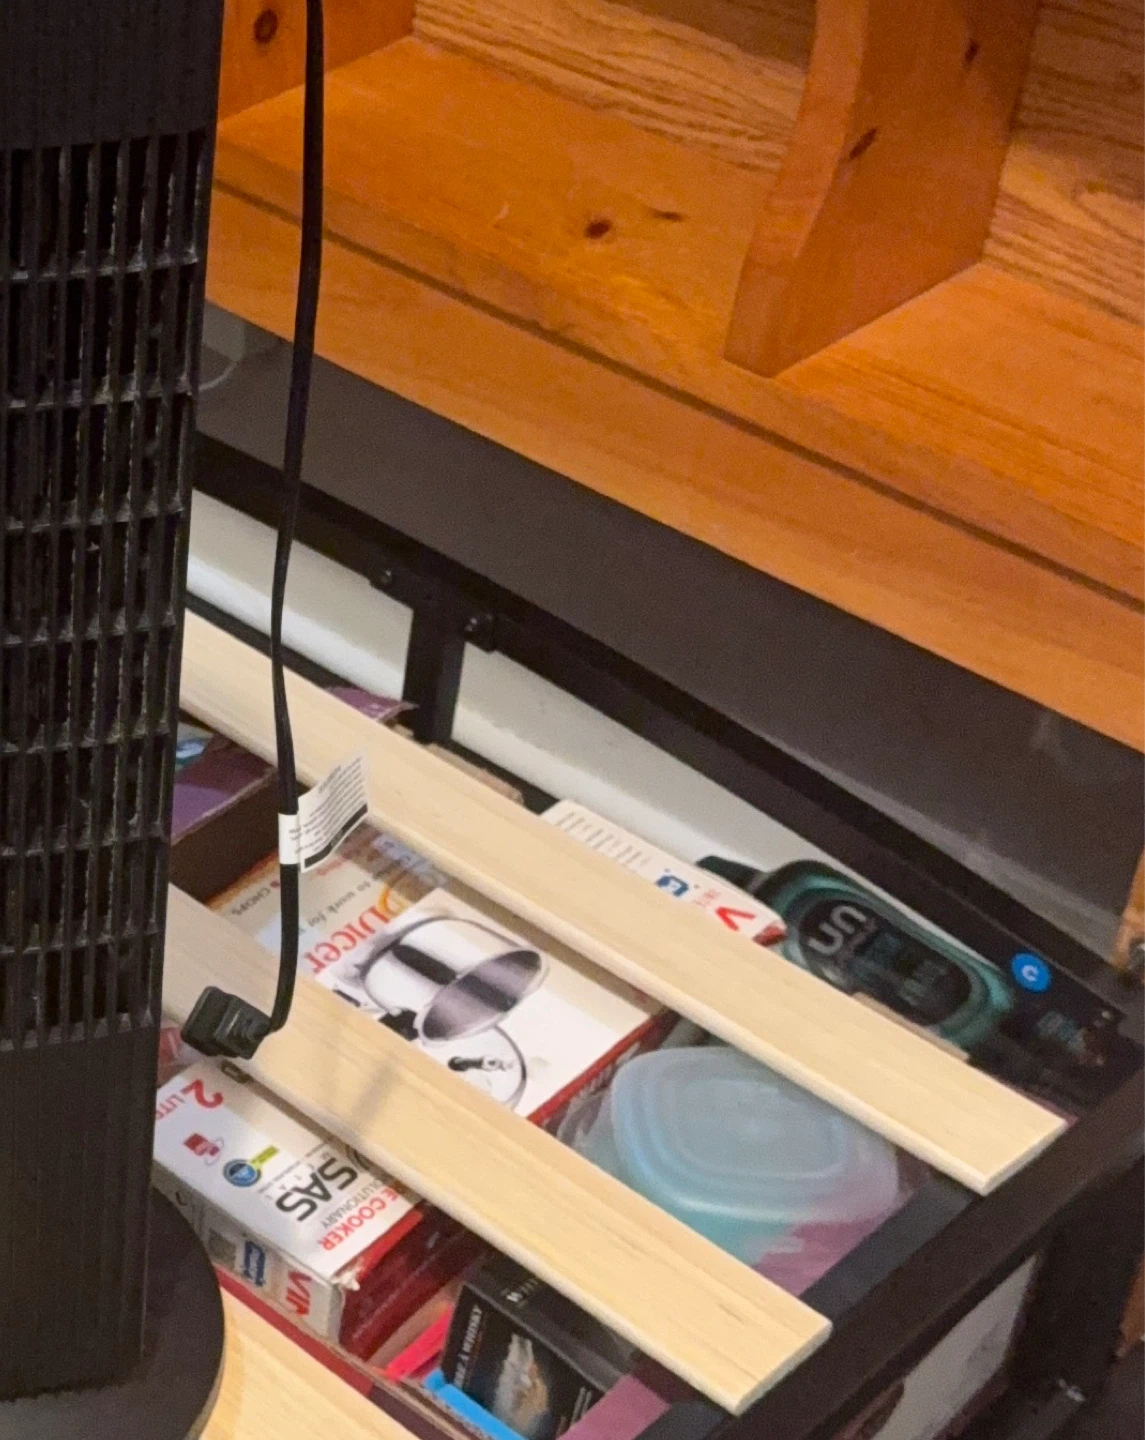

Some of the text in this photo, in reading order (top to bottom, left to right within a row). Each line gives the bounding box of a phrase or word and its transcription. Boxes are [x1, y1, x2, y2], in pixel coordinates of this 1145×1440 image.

[180, 1079, 224, 1109] 2
[275, 1156, 358, 1222] SAS
[316, 1196, 387, 1252] COOKER
